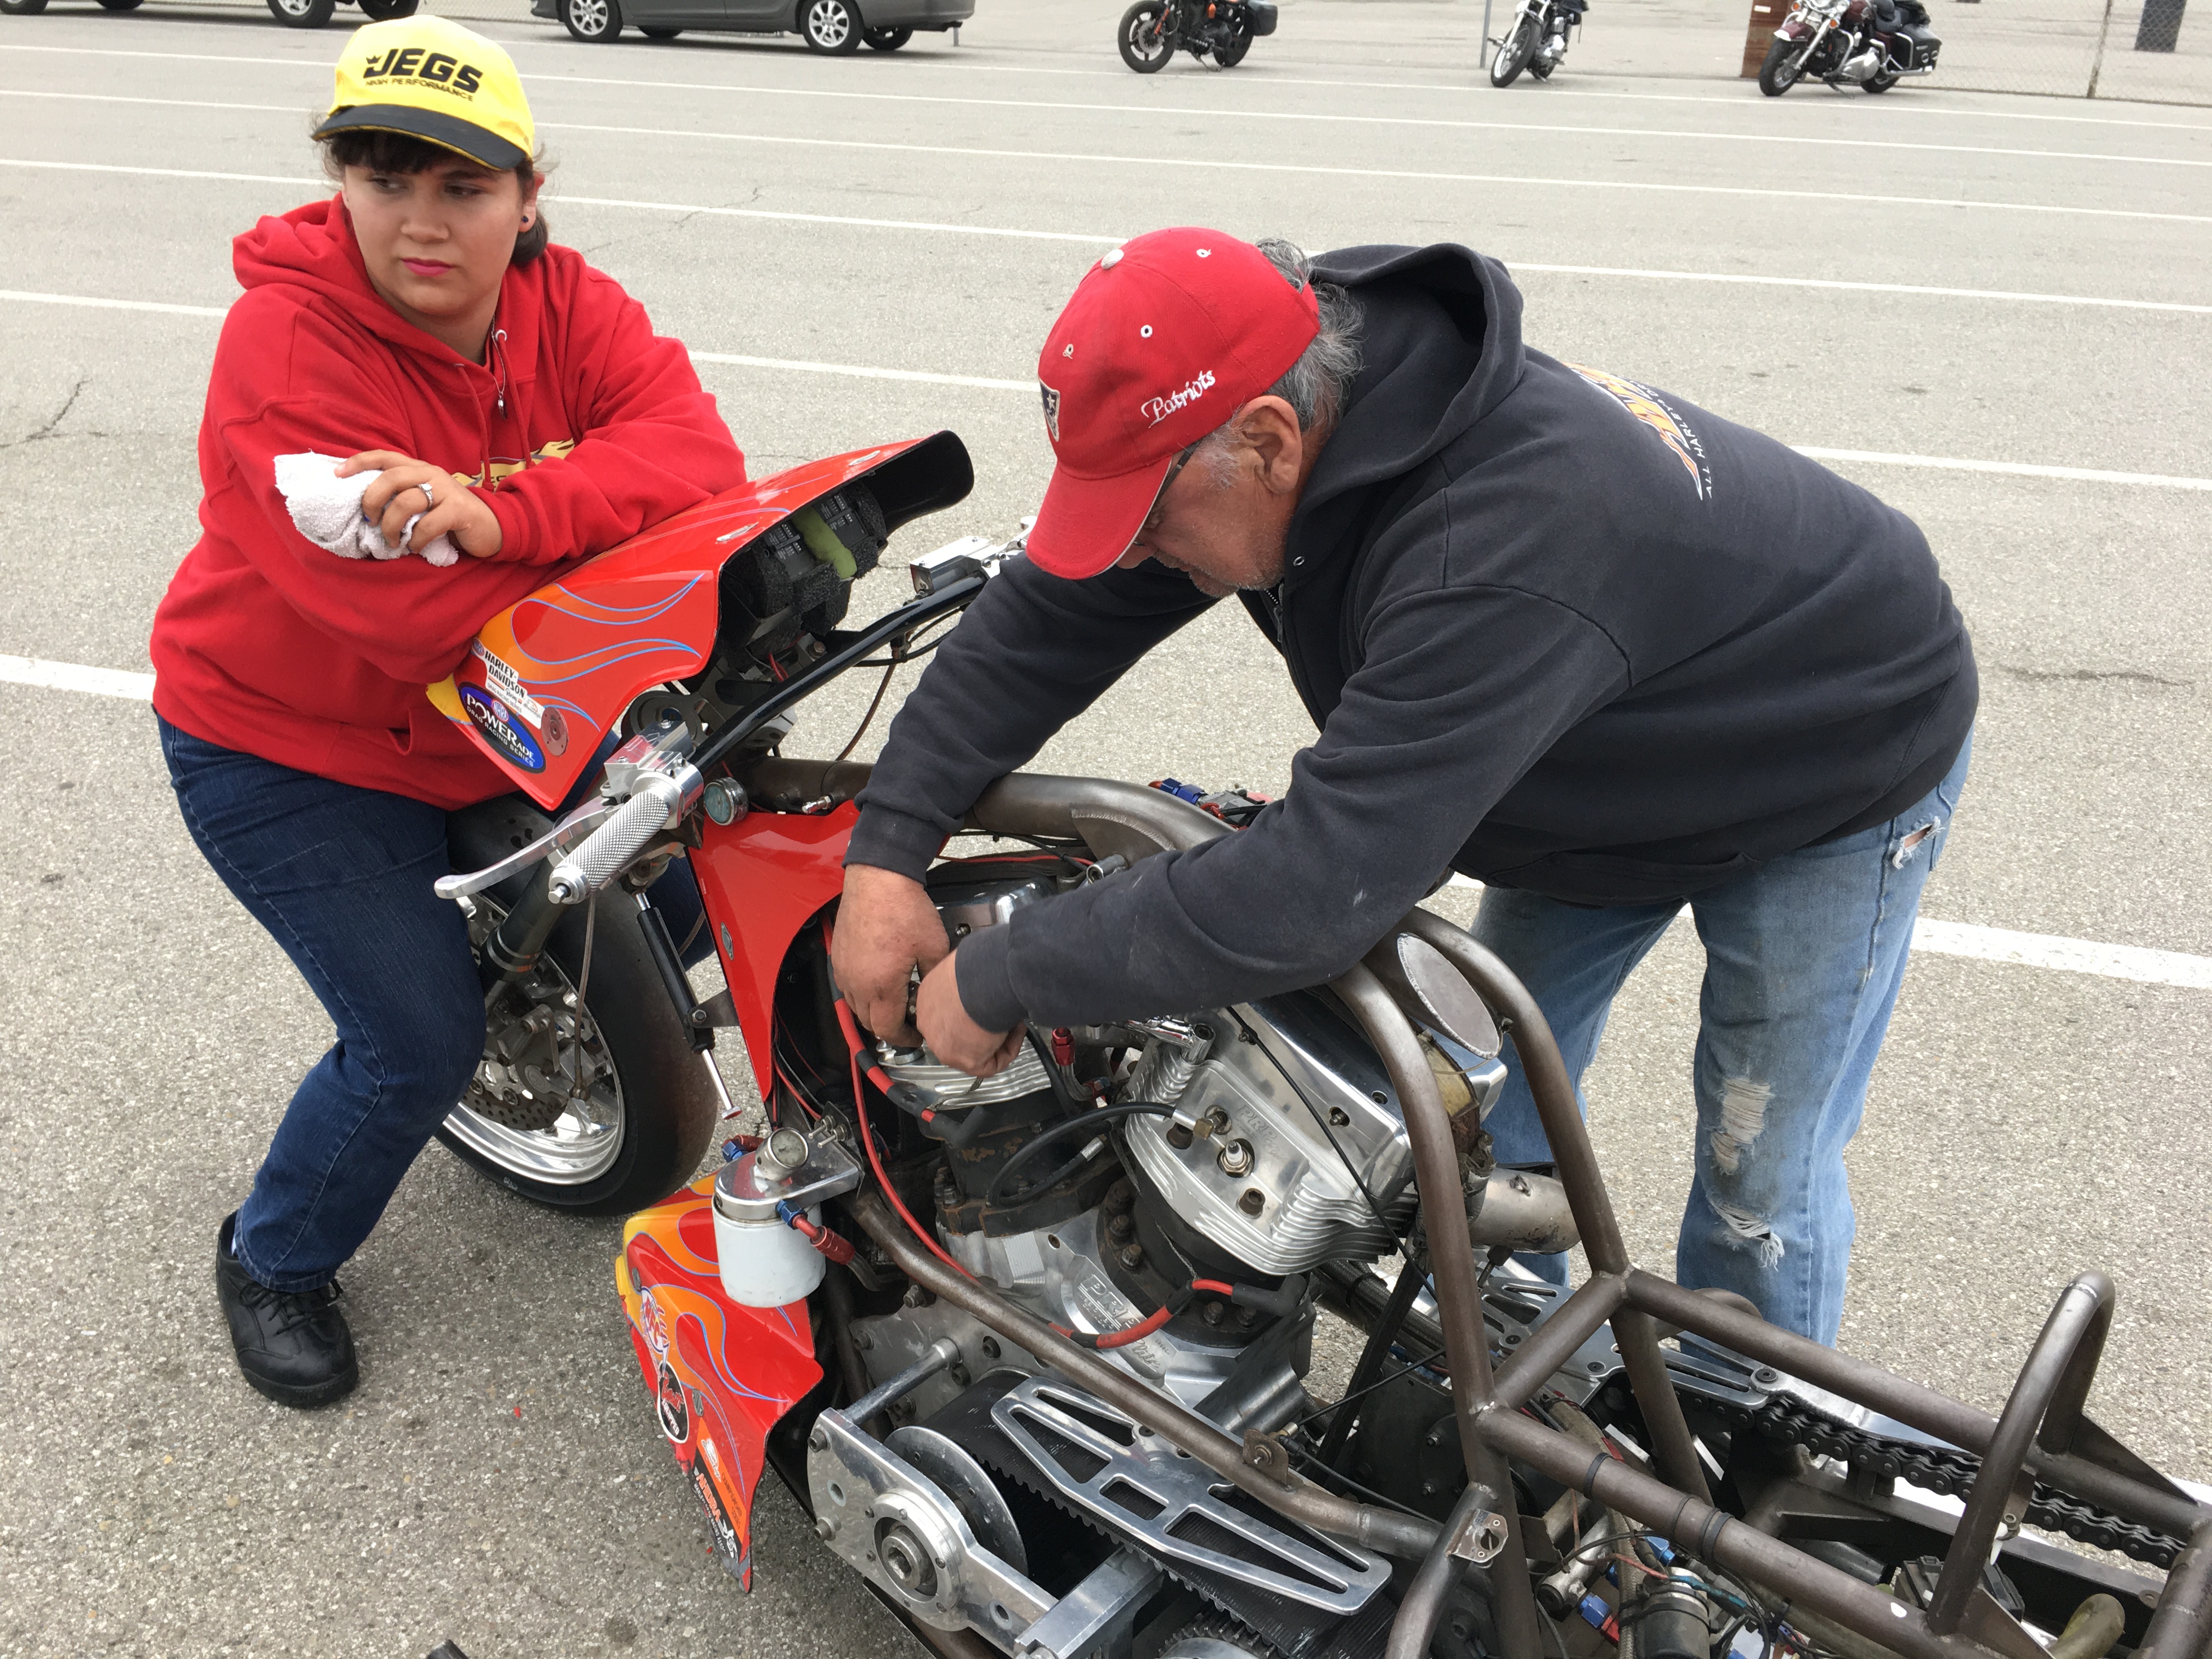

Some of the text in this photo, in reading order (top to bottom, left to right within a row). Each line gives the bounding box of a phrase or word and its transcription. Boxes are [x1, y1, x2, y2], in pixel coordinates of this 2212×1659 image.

[363, 48, 484, 94] JEGS
[365, 77, 473, 102] HIGH PERFORMANCE
[1141, 370, 1216, 428] Patriots
[1702, 466, 1712, 499] ALL
[489, 664, 525, 698] DAVIDSON
[494, 702, 508, 720] NHRA
[467, 706, 534, 767] DRAG RACING SERIES
[661, 1399, 680, 1436] EQUIPPED
[710, 1518, 719, 1536] RACING
